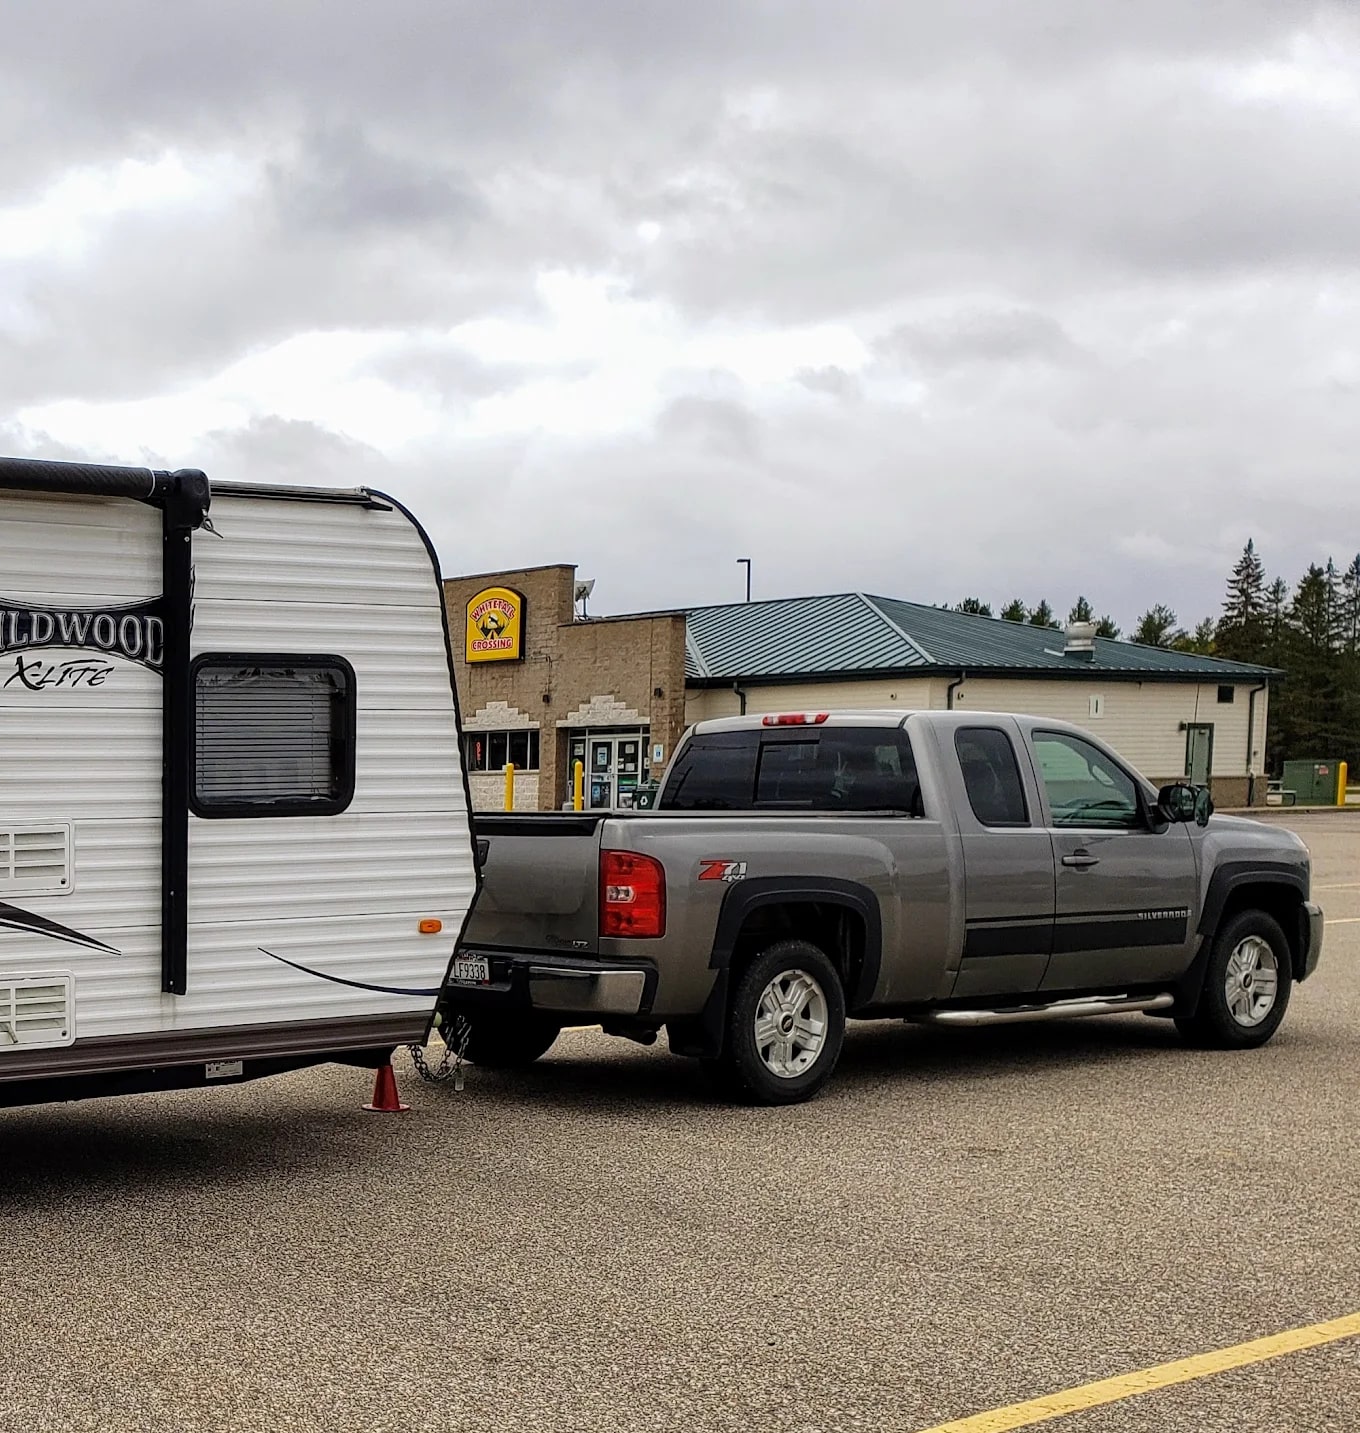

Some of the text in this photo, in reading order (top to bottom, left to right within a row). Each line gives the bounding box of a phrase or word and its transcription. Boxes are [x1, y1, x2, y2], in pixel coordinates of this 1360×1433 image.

[471, 599, 515, 621] WHITETAIL
[472, 638, 513, 650] CROSSING
[4, 656, 115, 691] X-LITE
[698, 860, 747, 880] Z71
